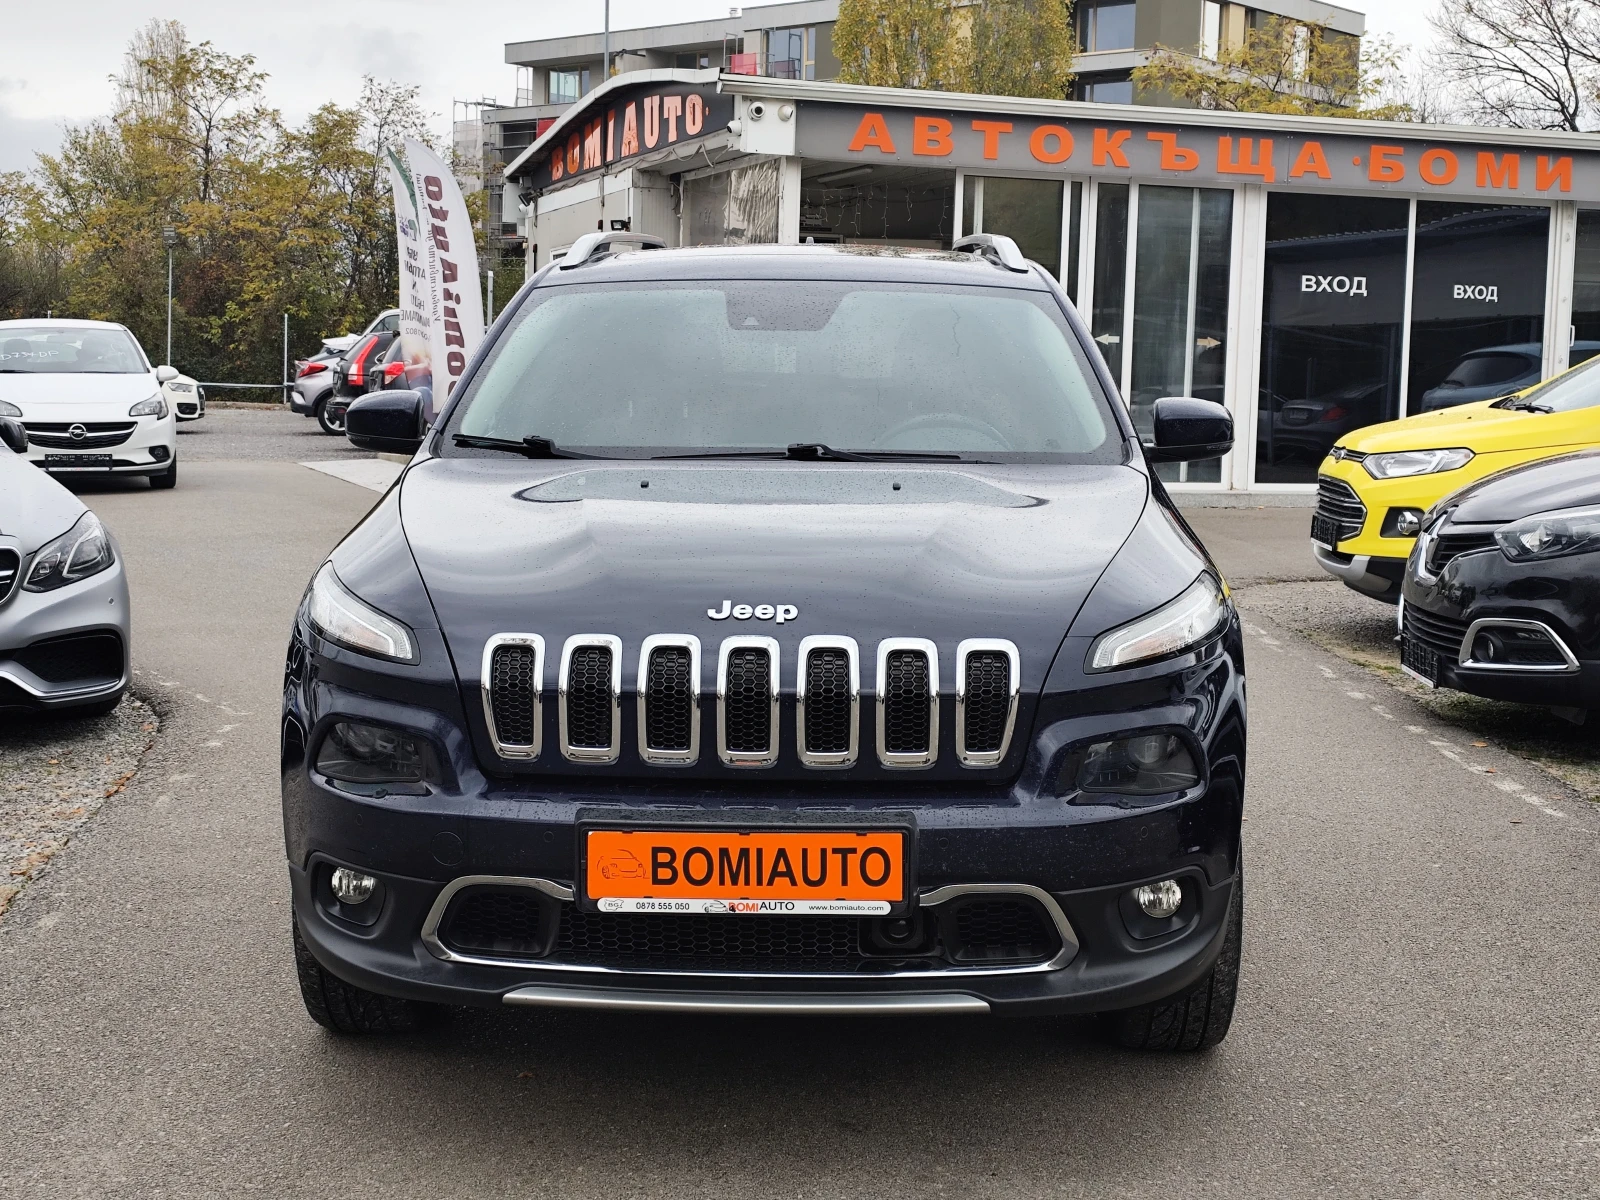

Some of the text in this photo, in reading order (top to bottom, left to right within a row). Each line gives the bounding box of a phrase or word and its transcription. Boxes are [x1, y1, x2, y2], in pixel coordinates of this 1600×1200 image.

[848, 112, 1573, 192] АВТОКЪЩА БОМИ
[1453, 285, 1498, 302] ВХОД
[707, 600, 799, 624] Jeep
[651, 846, 892, 888] BOMIAUTO
[635, 902, 656, 910] 0878
[657, 902, 673, 910] 555
